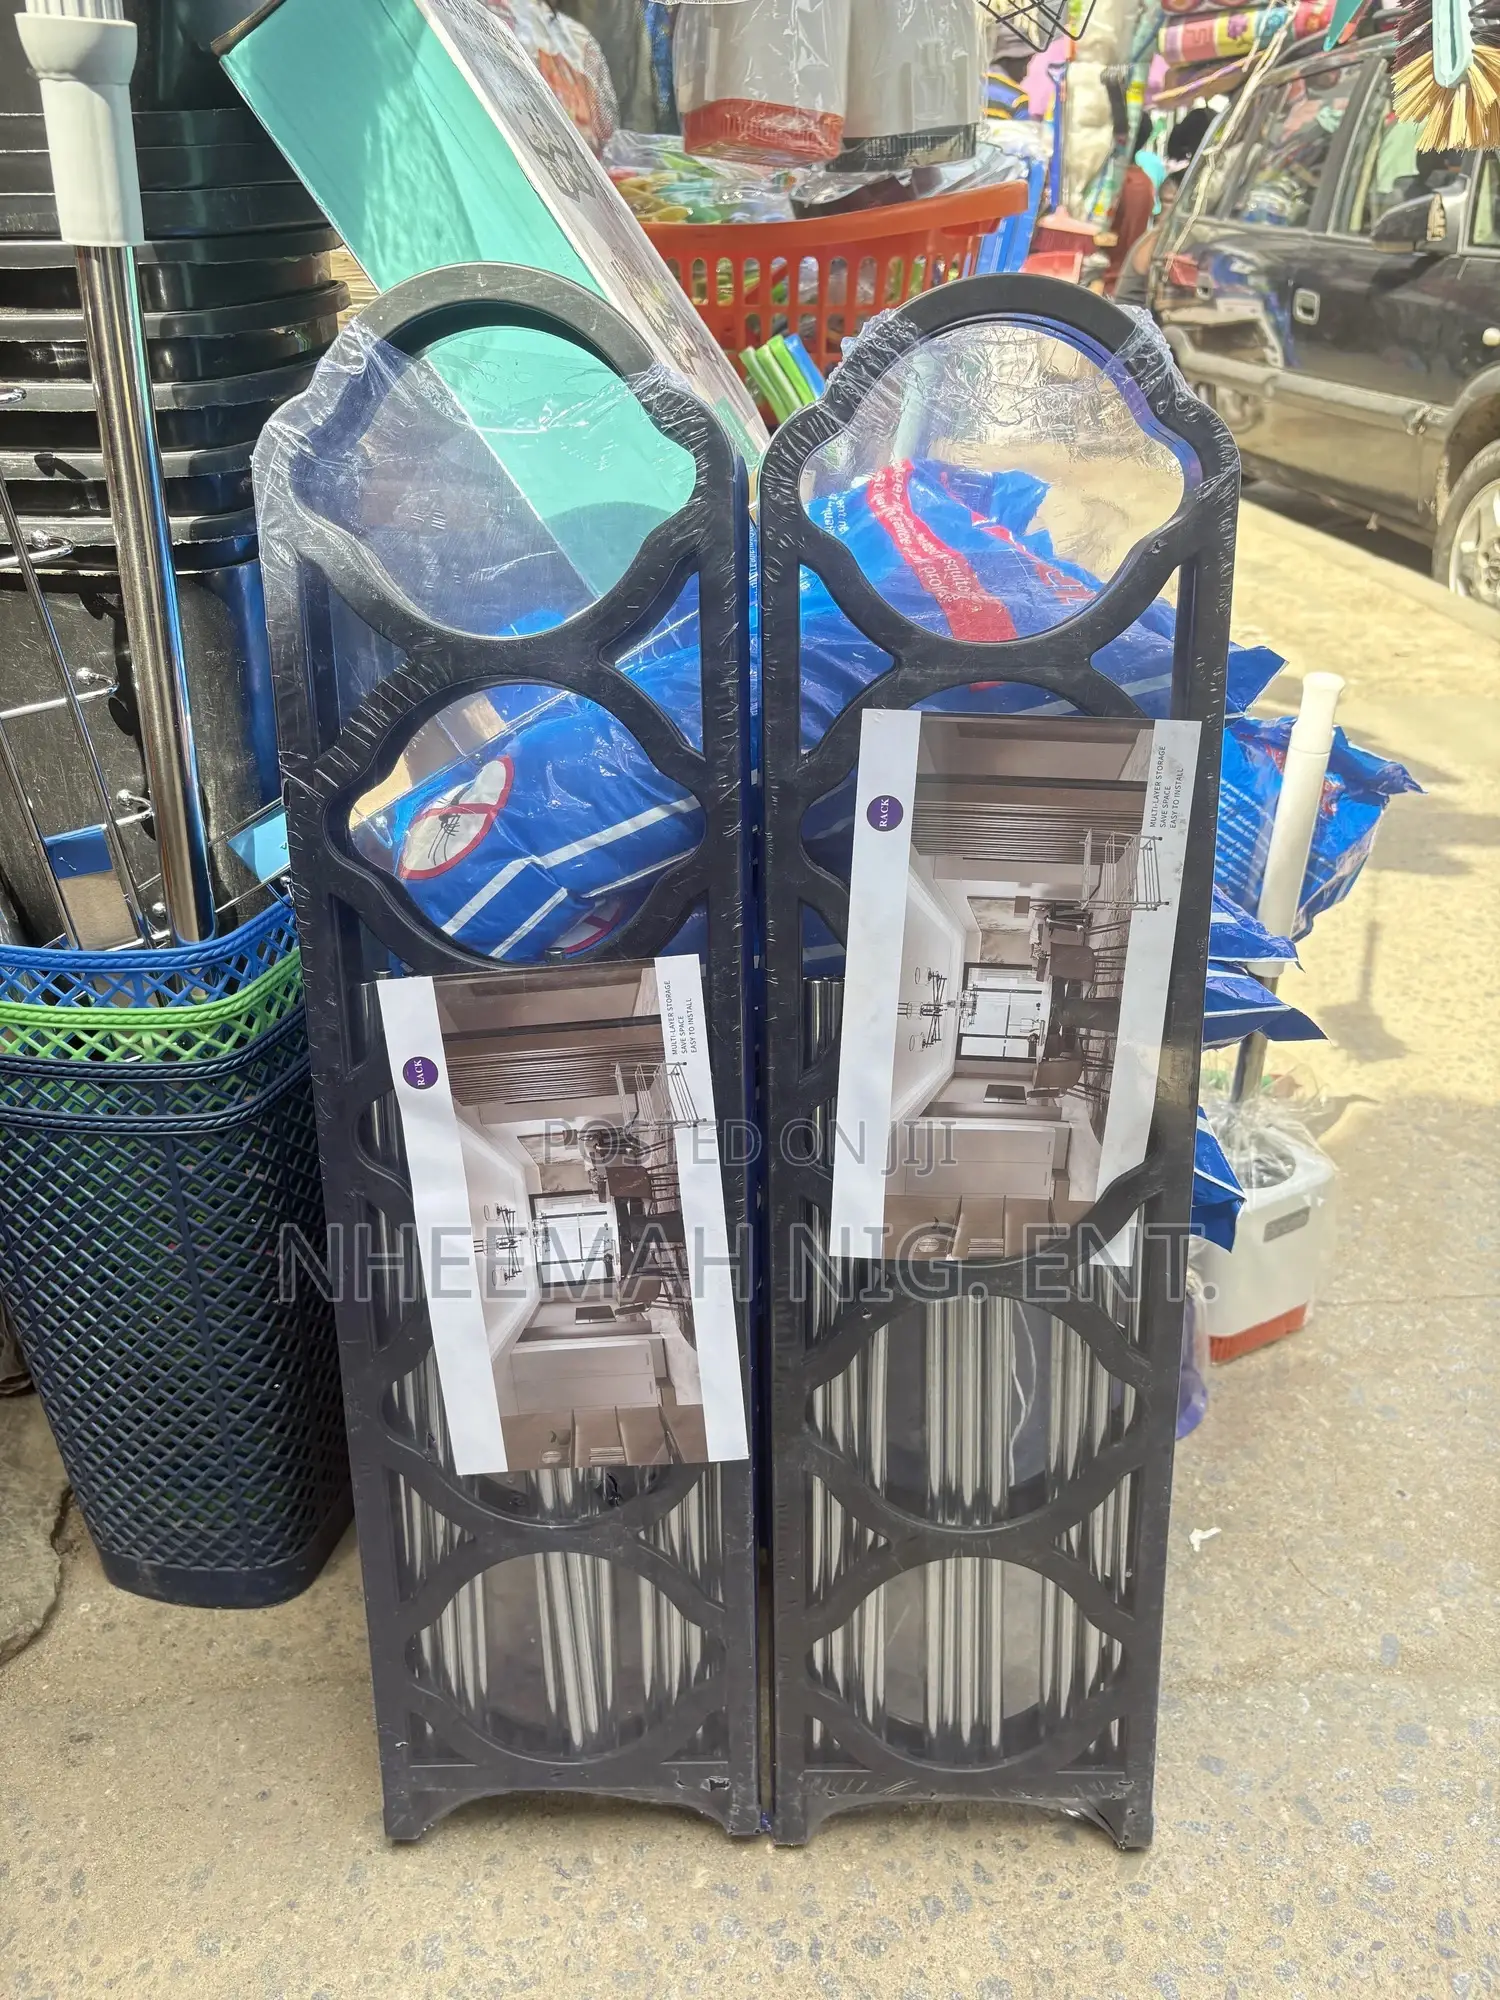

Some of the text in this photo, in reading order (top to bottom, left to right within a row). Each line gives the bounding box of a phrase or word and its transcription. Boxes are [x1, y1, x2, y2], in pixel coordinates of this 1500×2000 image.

[1149, 746, 1166, 828] MULTI-LAYER STORAGE
[1160, 785, 1171, 828] SAVE SPACE
[1170, 768, 1184, 829] EASY TO INSTALL
[879, 798, 890, 827] RACK
[664, 980, 677, 1055] MULTI-LAYER STORAGE
[678, 1015, 688, 1054] SAVE SPACE
[686, 998, 697, 1054] EASY TO INSTALL
[413, 1059, 426, 1086] RACK
